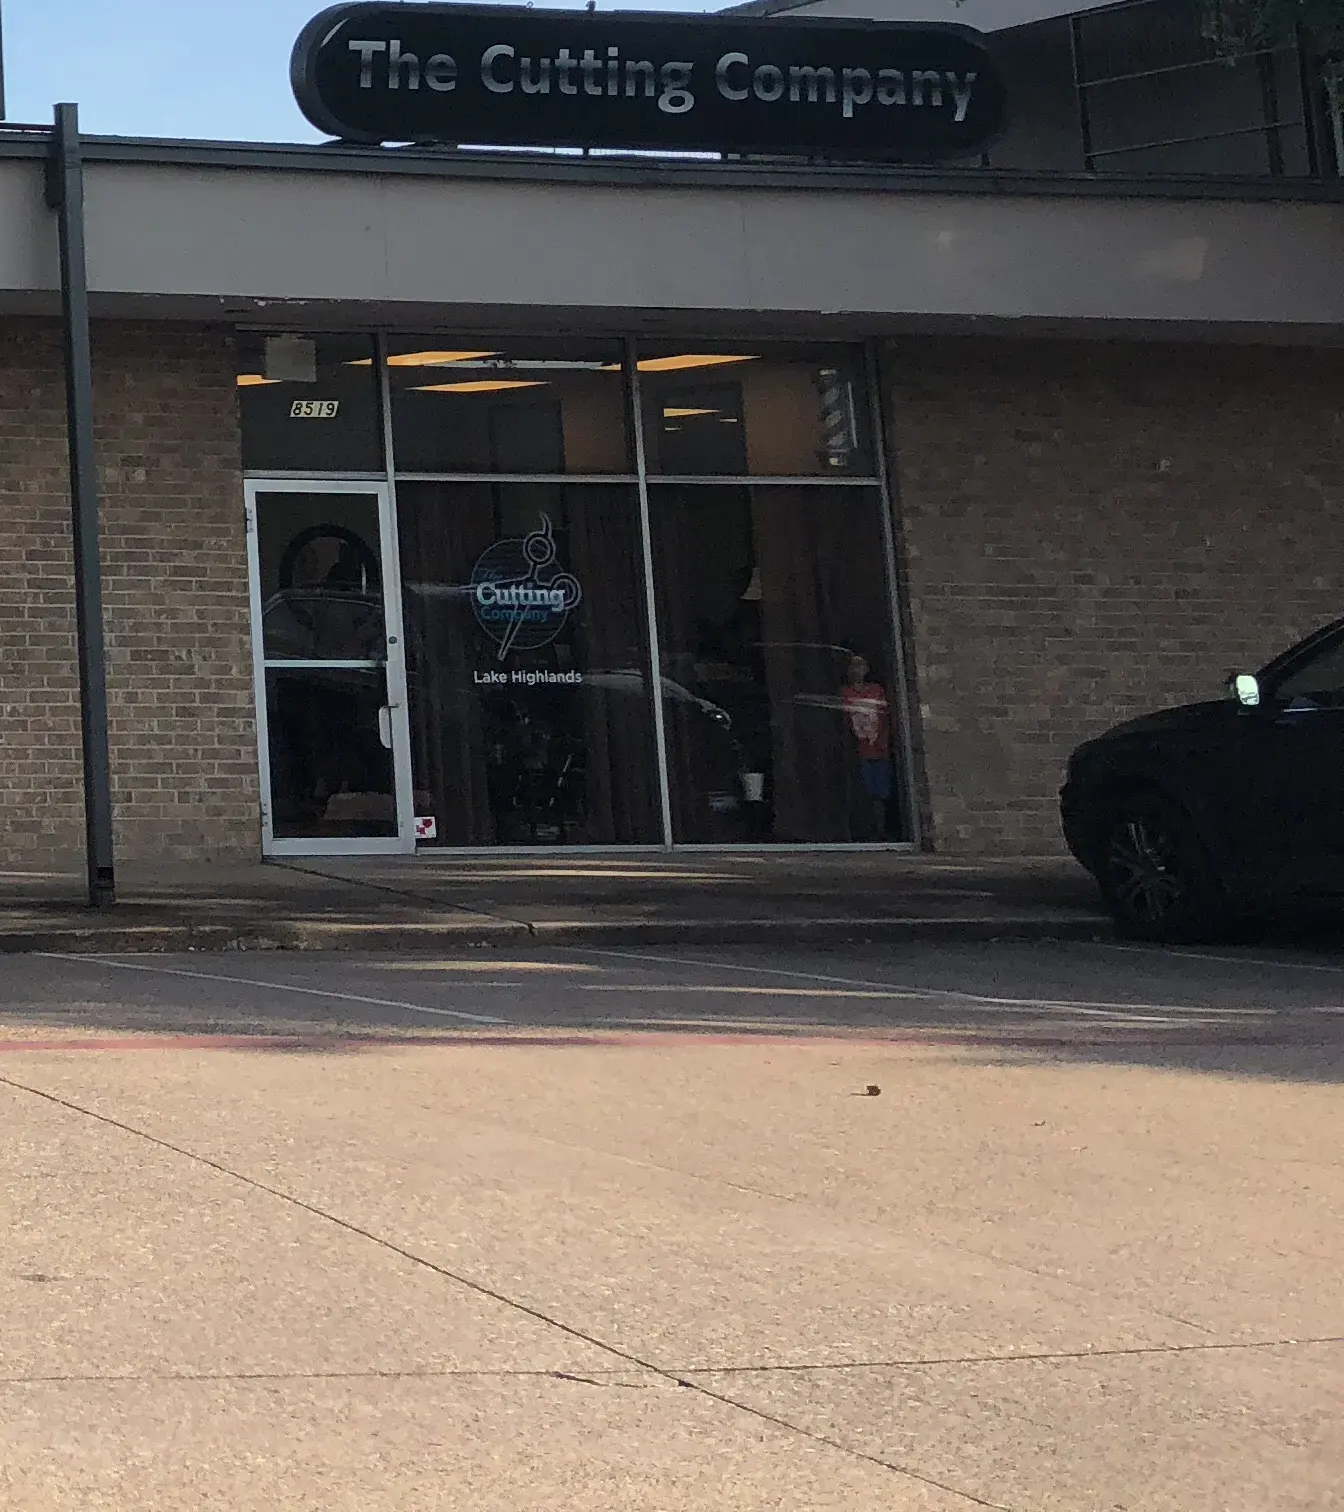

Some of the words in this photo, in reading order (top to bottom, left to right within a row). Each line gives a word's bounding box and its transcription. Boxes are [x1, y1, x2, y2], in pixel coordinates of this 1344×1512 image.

[348, 40, 458, 92] The
[480, 44, 695, 114] Cutting
[714, 51, 977, 121] Company
[292, 401, 336, 417] 8519
[476, 582, 566, 612] Cutting
[473, 670, 508, 684] Lake
[512, 669, 583, 686] Highlands
